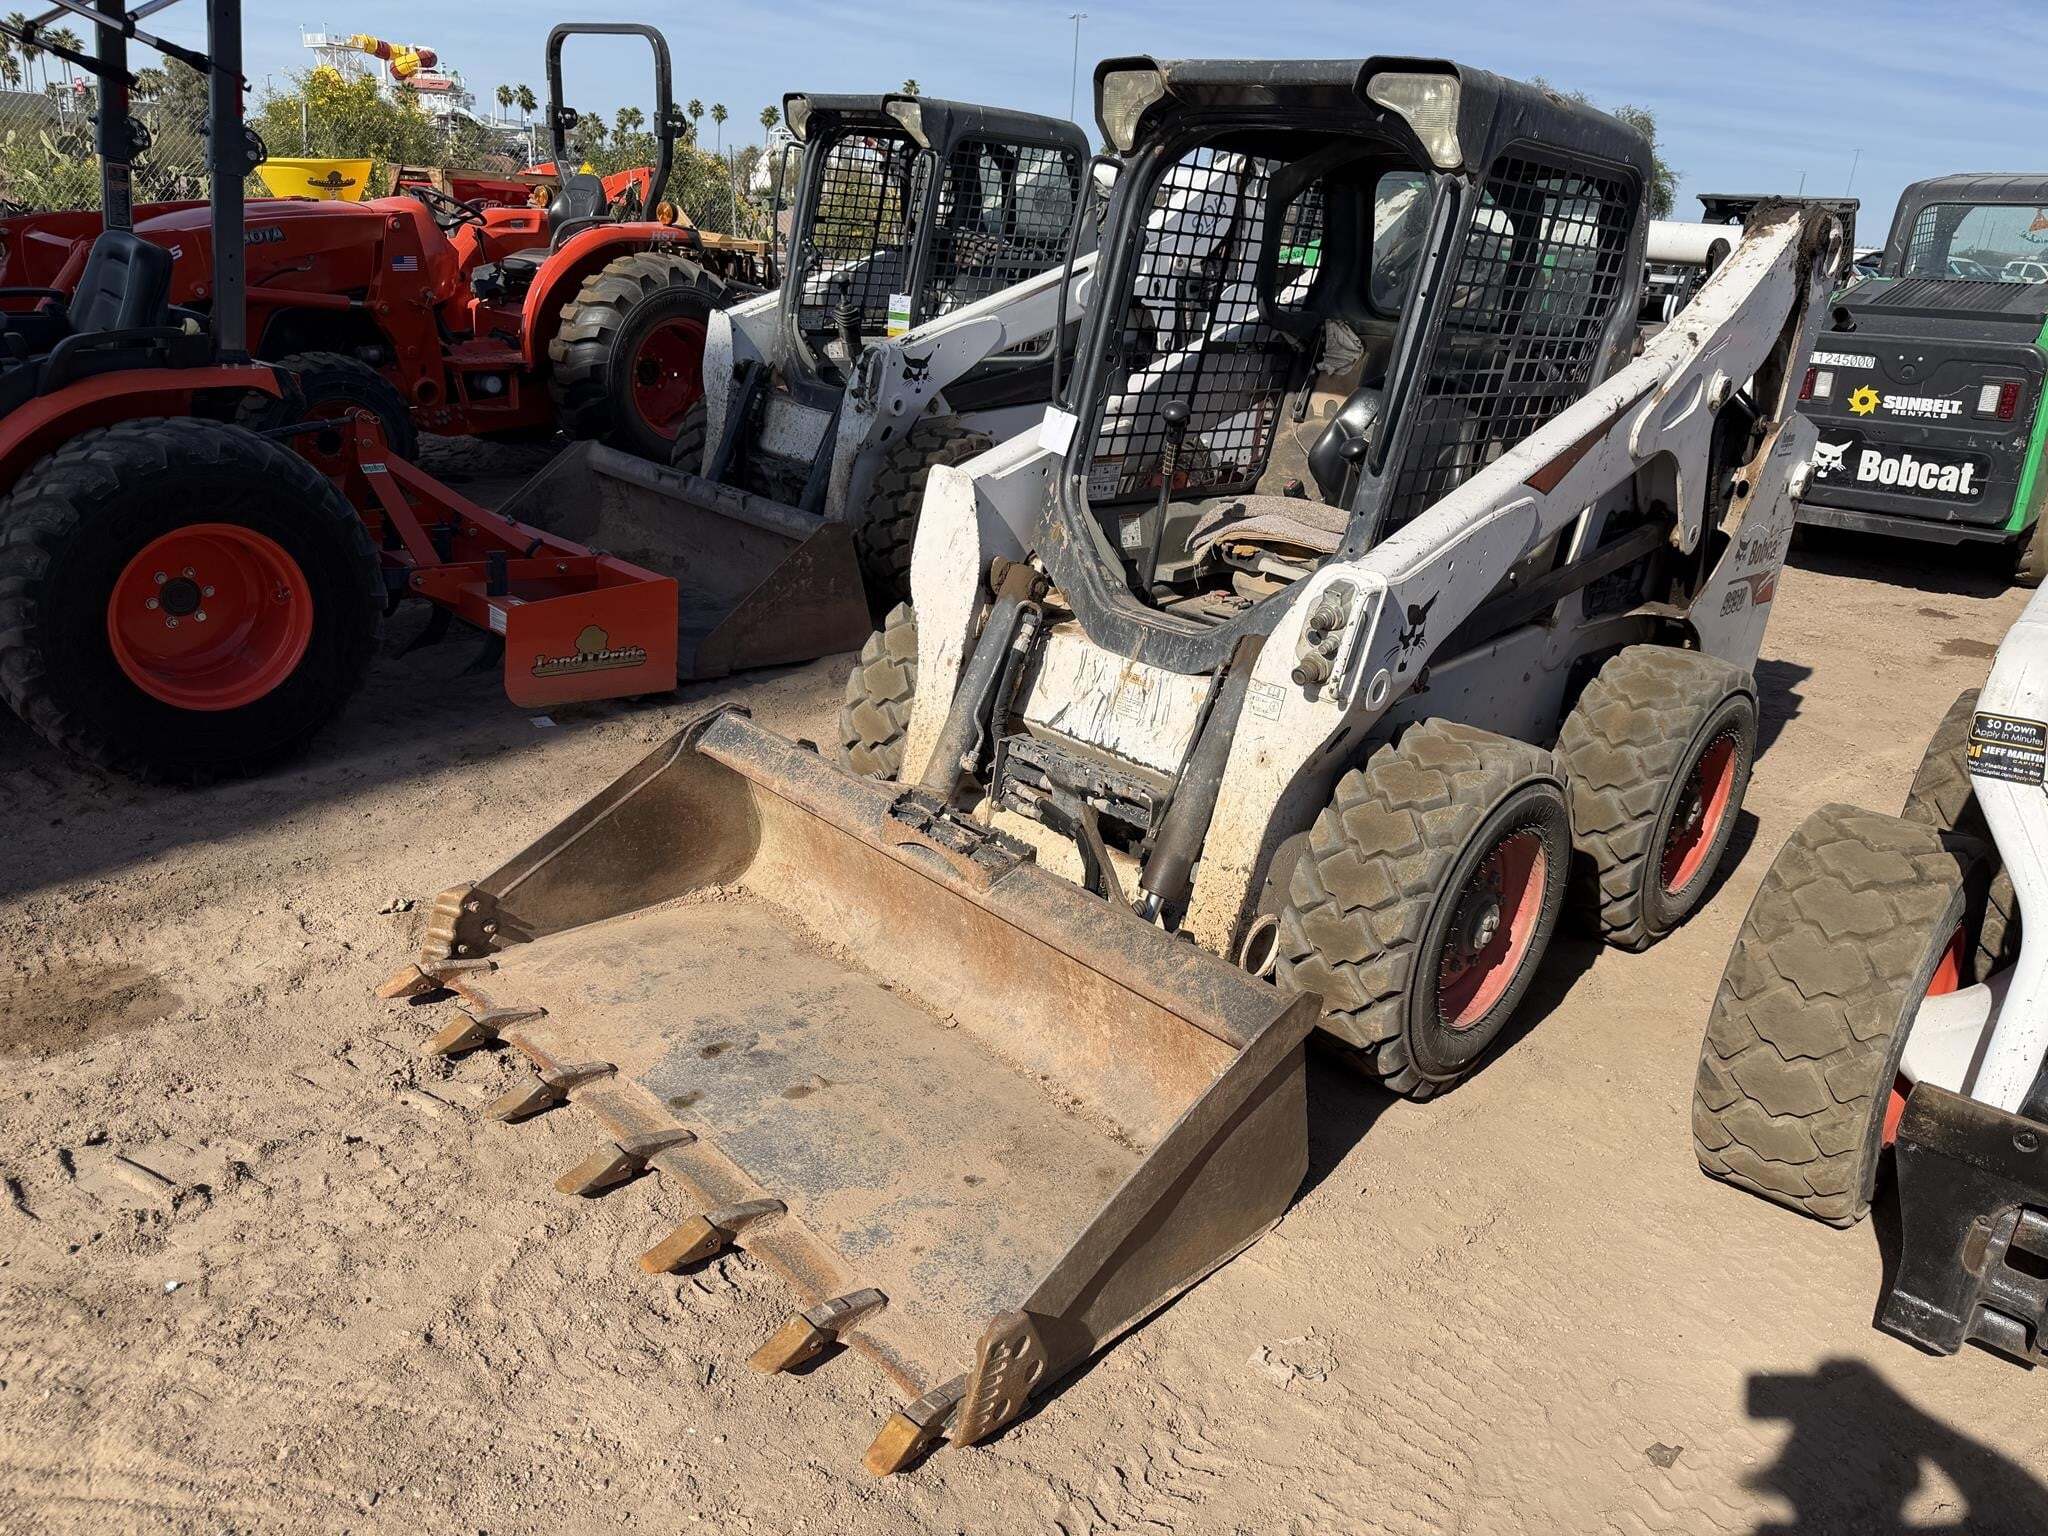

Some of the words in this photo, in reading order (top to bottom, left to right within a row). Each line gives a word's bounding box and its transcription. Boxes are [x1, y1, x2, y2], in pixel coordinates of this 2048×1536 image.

[1882, 395, 1962, 414] SUNBELT
[1891, 409, 1948, 419] RENTALS
[1856, 449, 1975, 494] Bobcat
[1987, 719, 2002, 730] $0
[2004, 722, 2037, 736] Down
[1974, 728, 2000, 739] Apply
[2011, 734, 2043, 746] Minutes
[1982, 745, 2007, 757] JEFF
[2007, 749, 2045, 763] MARTIN
